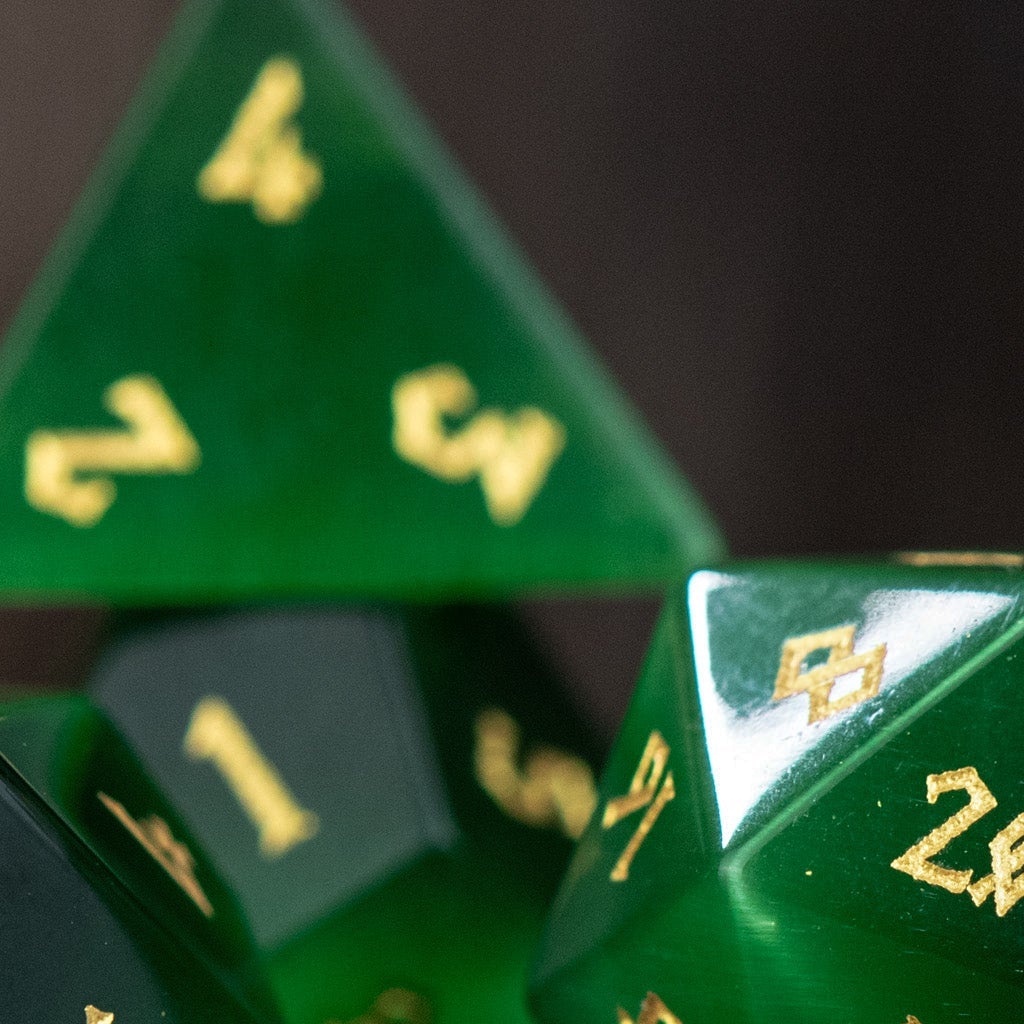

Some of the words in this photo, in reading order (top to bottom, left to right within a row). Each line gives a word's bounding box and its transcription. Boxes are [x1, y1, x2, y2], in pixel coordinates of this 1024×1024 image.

[199, 57, 323, 224] 4
[775, 624, 887, 724] 8
[184, 697, 318, 858] 1
